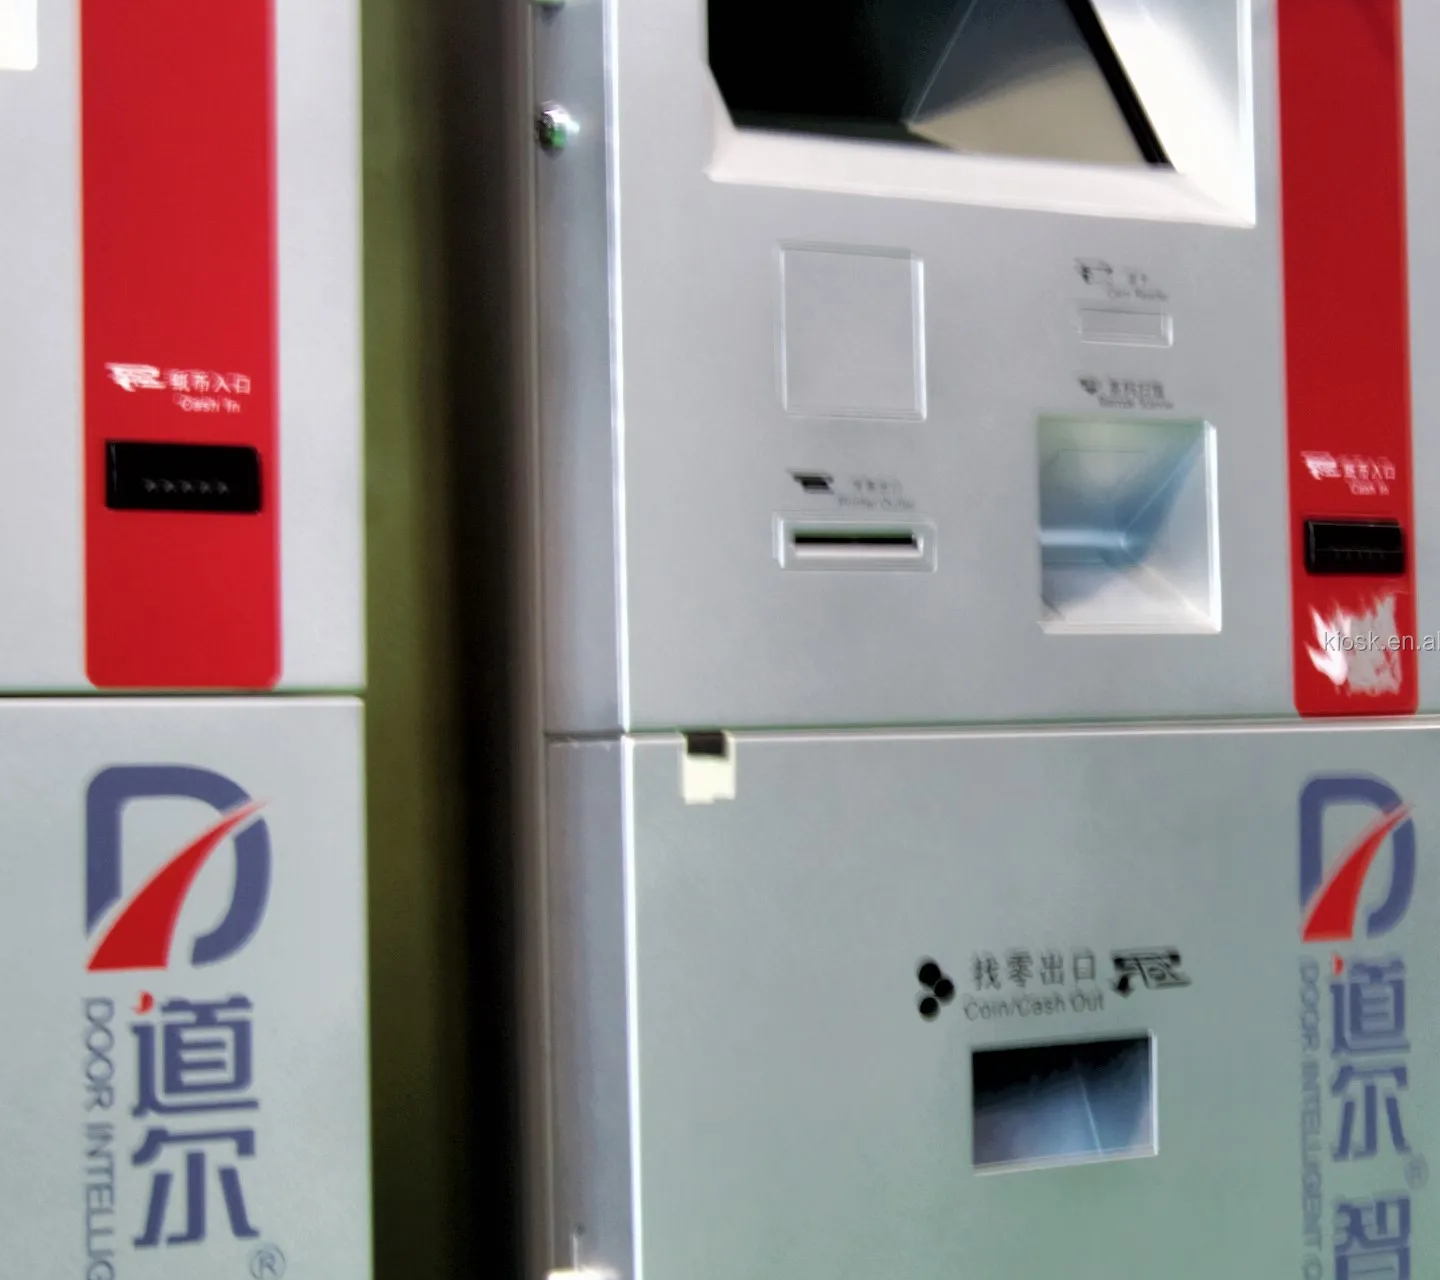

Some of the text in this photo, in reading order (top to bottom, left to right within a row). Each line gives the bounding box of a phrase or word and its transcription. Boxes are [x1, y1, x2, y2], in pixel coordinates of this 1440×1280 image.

[971, 948, 1097, 991] 找零出口
[84, 996, 116, 1113] DOOR
